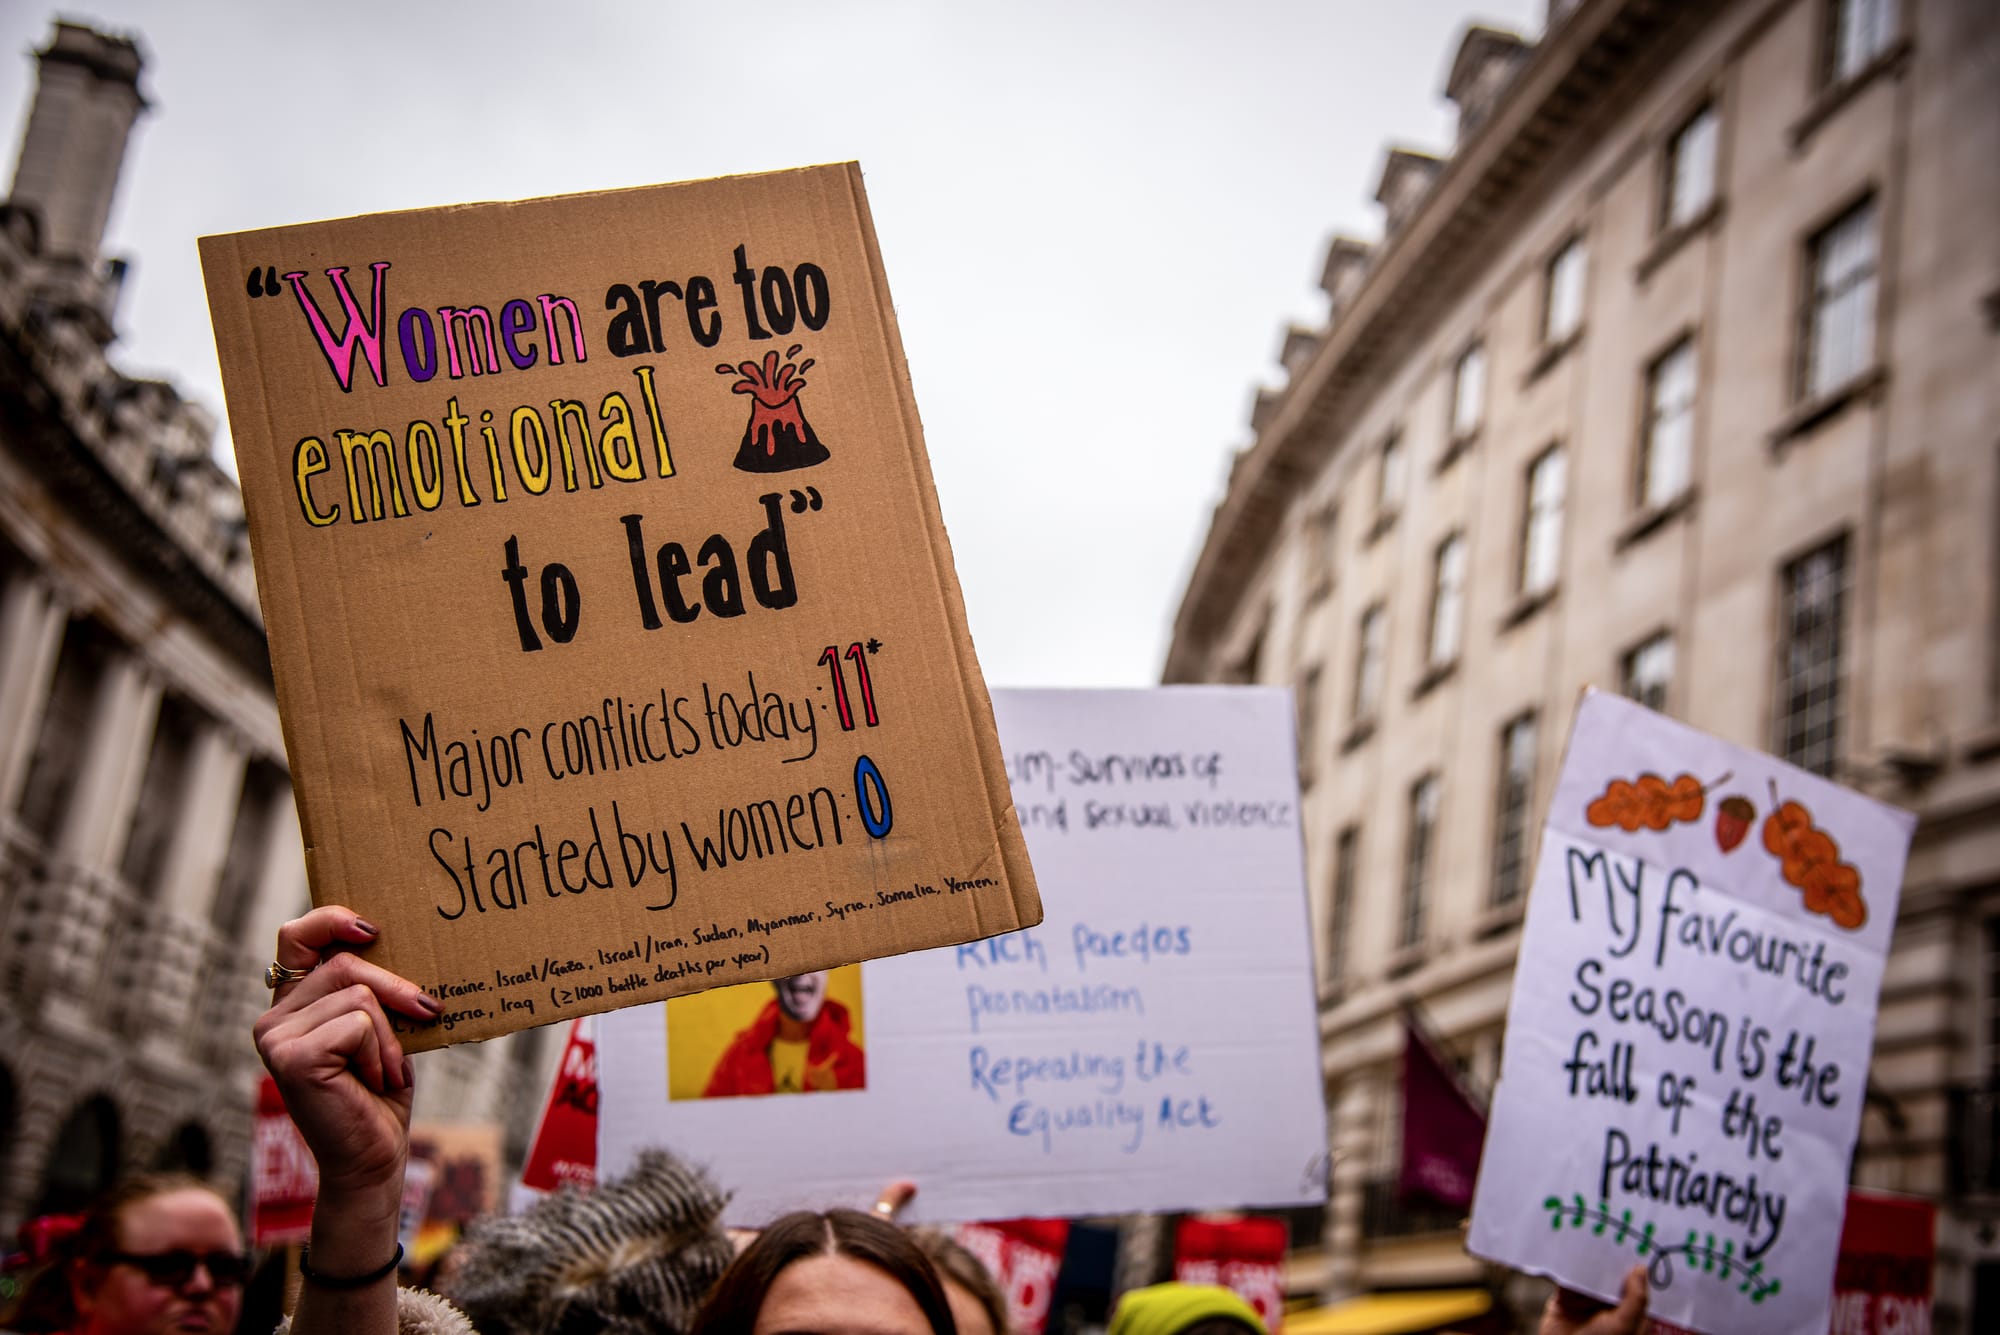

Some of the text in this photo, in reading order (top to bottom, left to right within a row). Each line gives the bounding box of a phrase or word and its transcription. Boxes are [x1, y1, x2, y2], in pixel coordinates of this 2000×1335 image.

[605, 273, 723, 358] are
[732, 243, 831, 340] too
[291, 366, 677, 528] emotional
[500, 534, 581, 652] to
[399, 712, 532, 812] Major
[540, 688, 701, 780] conflicts
[703, 671, 829, 765] today:
[1192, 750, 1225, 790] of
[427, 754, 895, 920] Started by women: 0
[692, 923, 744, 946] Sudan,
[747, 910, 822, 935] Myanmar,
[825, 901, 875, 920] Syria,
[1565, 845, 1850, 1006] My favourite
[500, 997, 535, 1015] Iraq
[608, 975, 649, 994] battle
[654, 960, 704, 983] deaths
[705, 956, 728, 976] per
[968, 1038, 1193, 1103] Repealing the
[1563, 1028, 1784, 1162] fall of the
[1735, 1015, 1772, 1081] is
[1775, 1029, 1841, 1110] the
[1006, 1093, 1223, 1155] Equality Act
[1600, 1125, 1788, 1262] Patriarchy
